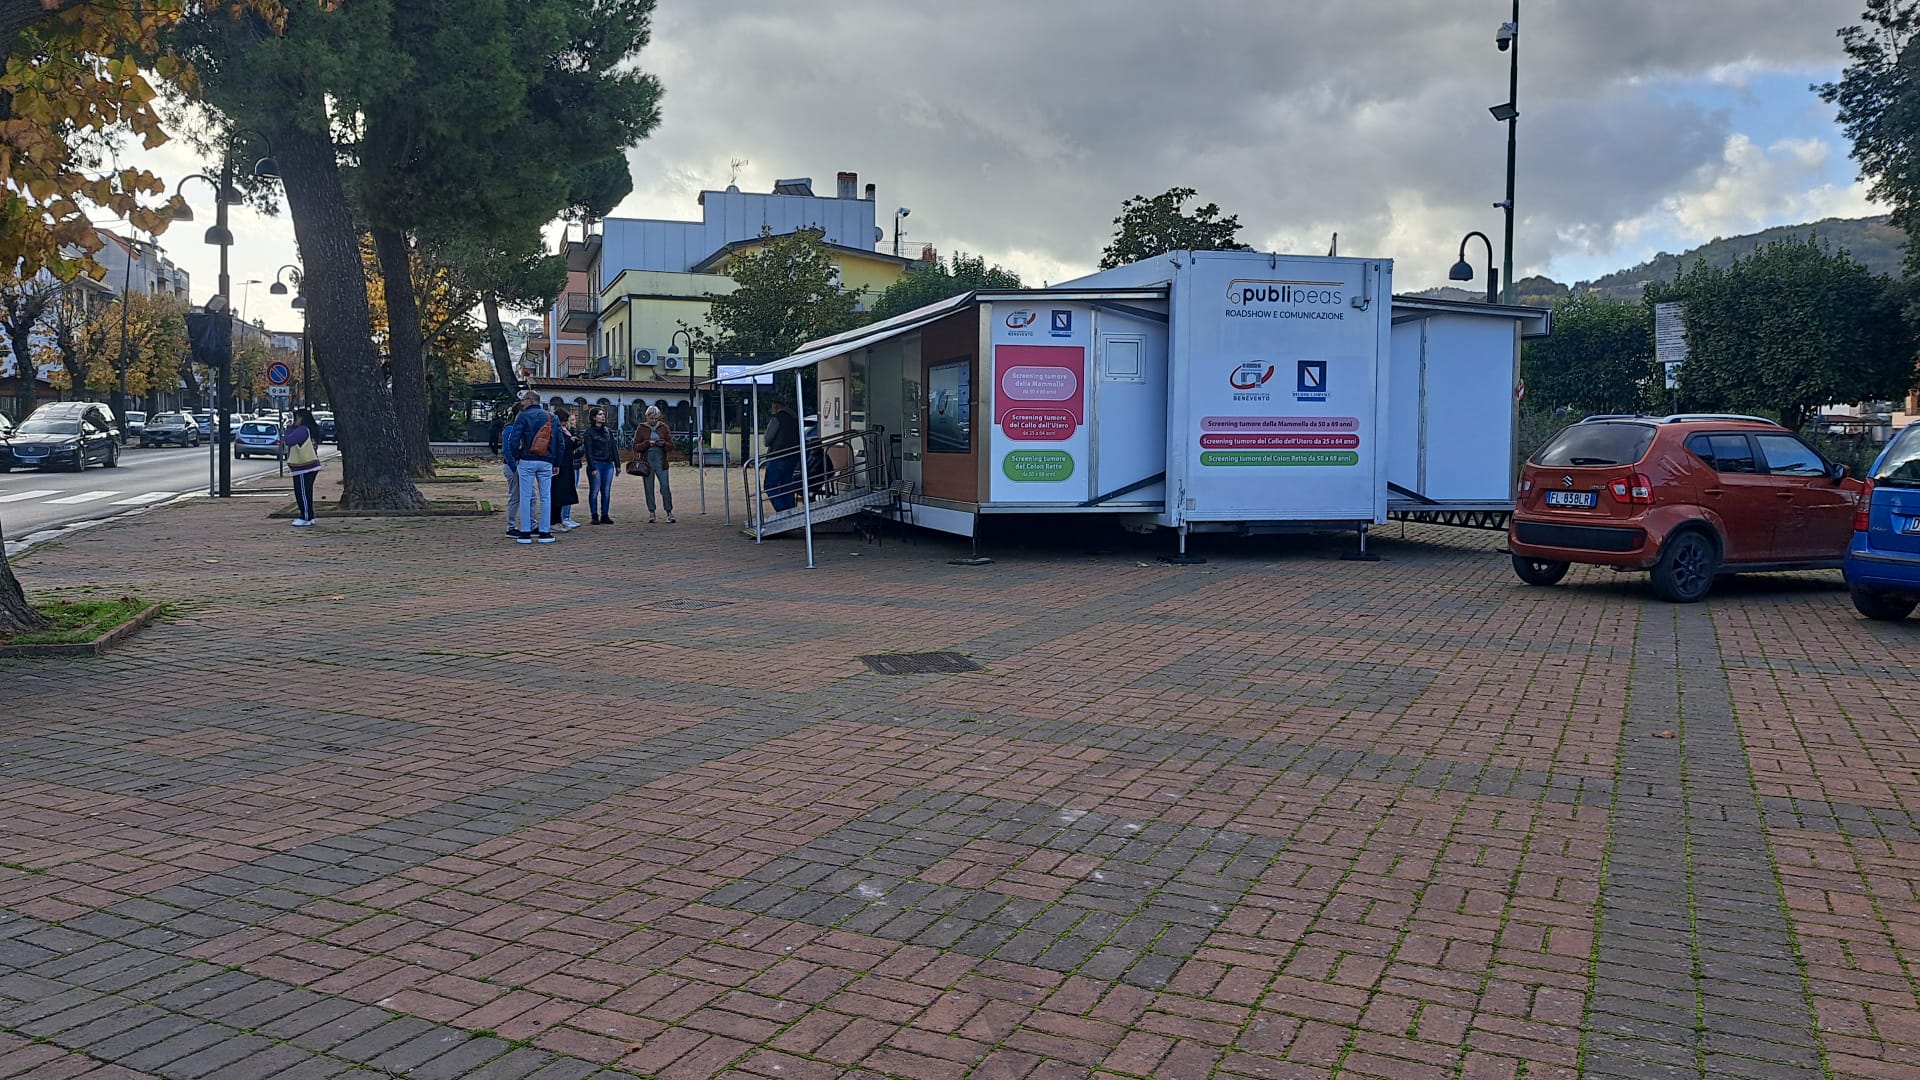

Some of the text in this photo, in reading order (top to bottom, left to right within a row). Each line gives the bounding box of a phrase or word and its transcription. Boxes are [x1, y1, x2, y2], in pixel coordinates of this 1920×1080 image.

[1243, 285, 1342, 308] publipeas
[1225, 309, 1272, 318] ROADSHOW
[1279, 311, 1344, 320] COMUNICAZIONE
[1207, 420, 1238, 428] Screening
[1208, 455, 1239, 463] Screening
